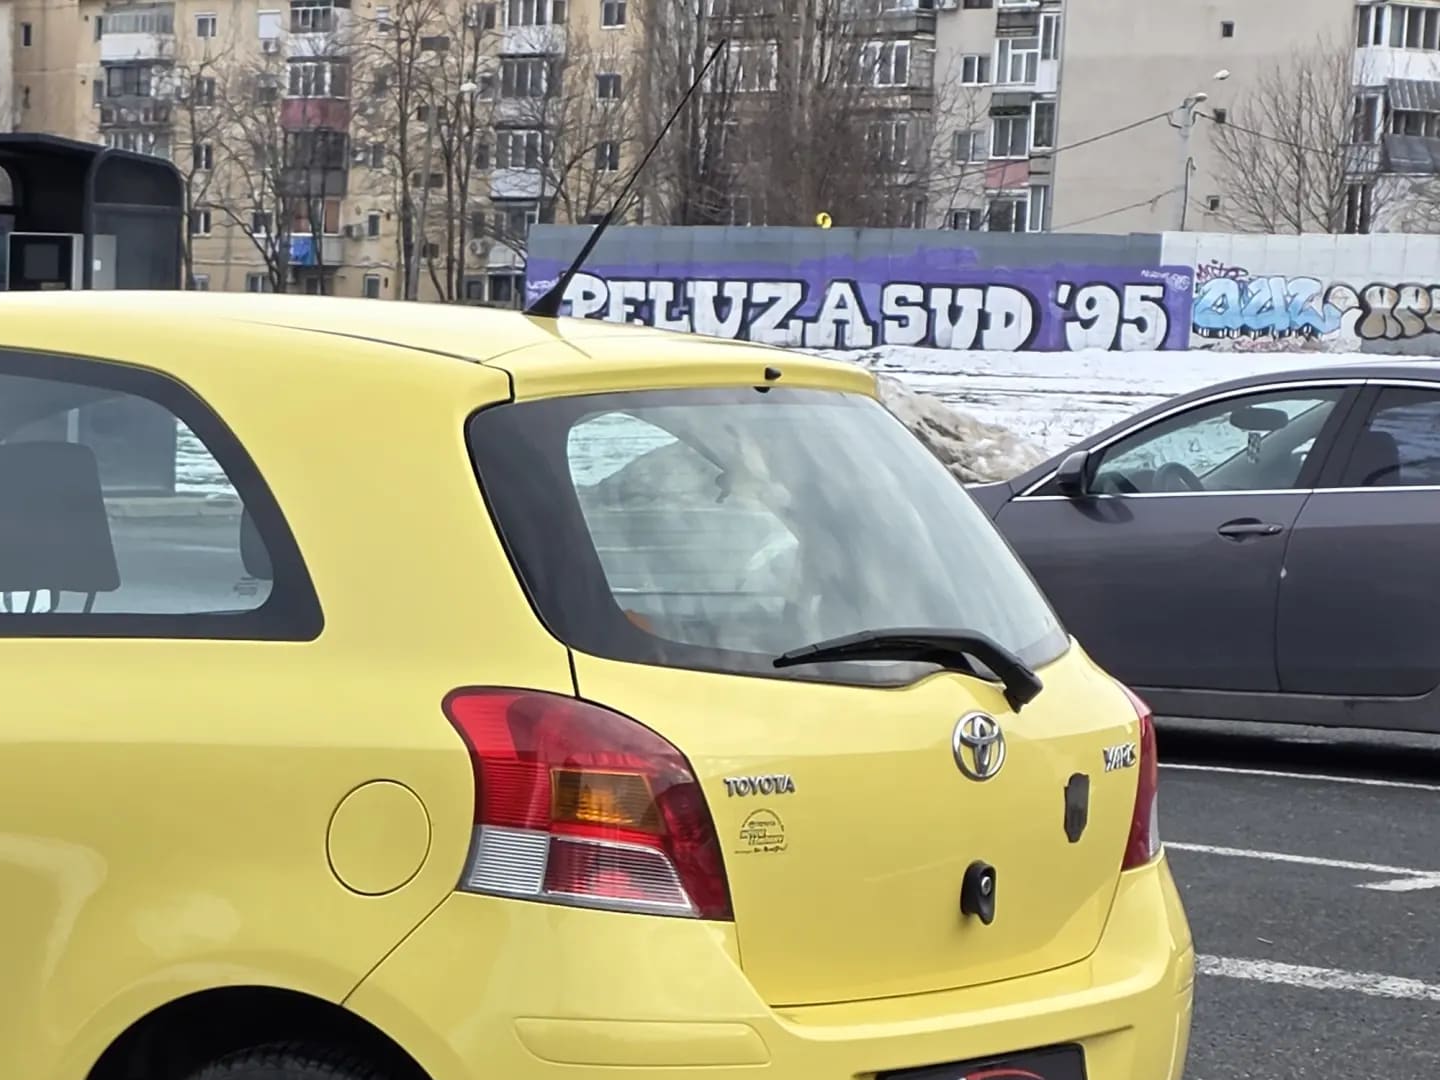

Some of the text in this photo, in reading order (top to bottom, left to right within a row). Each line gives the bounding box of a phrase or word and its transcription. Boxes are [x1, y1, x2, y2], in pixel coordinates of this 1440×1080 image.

[881, 283, 1034, 351] SUD
[1056, 283, 1168, 351] '95
[723, 774, 795, 797] TOYOTA
